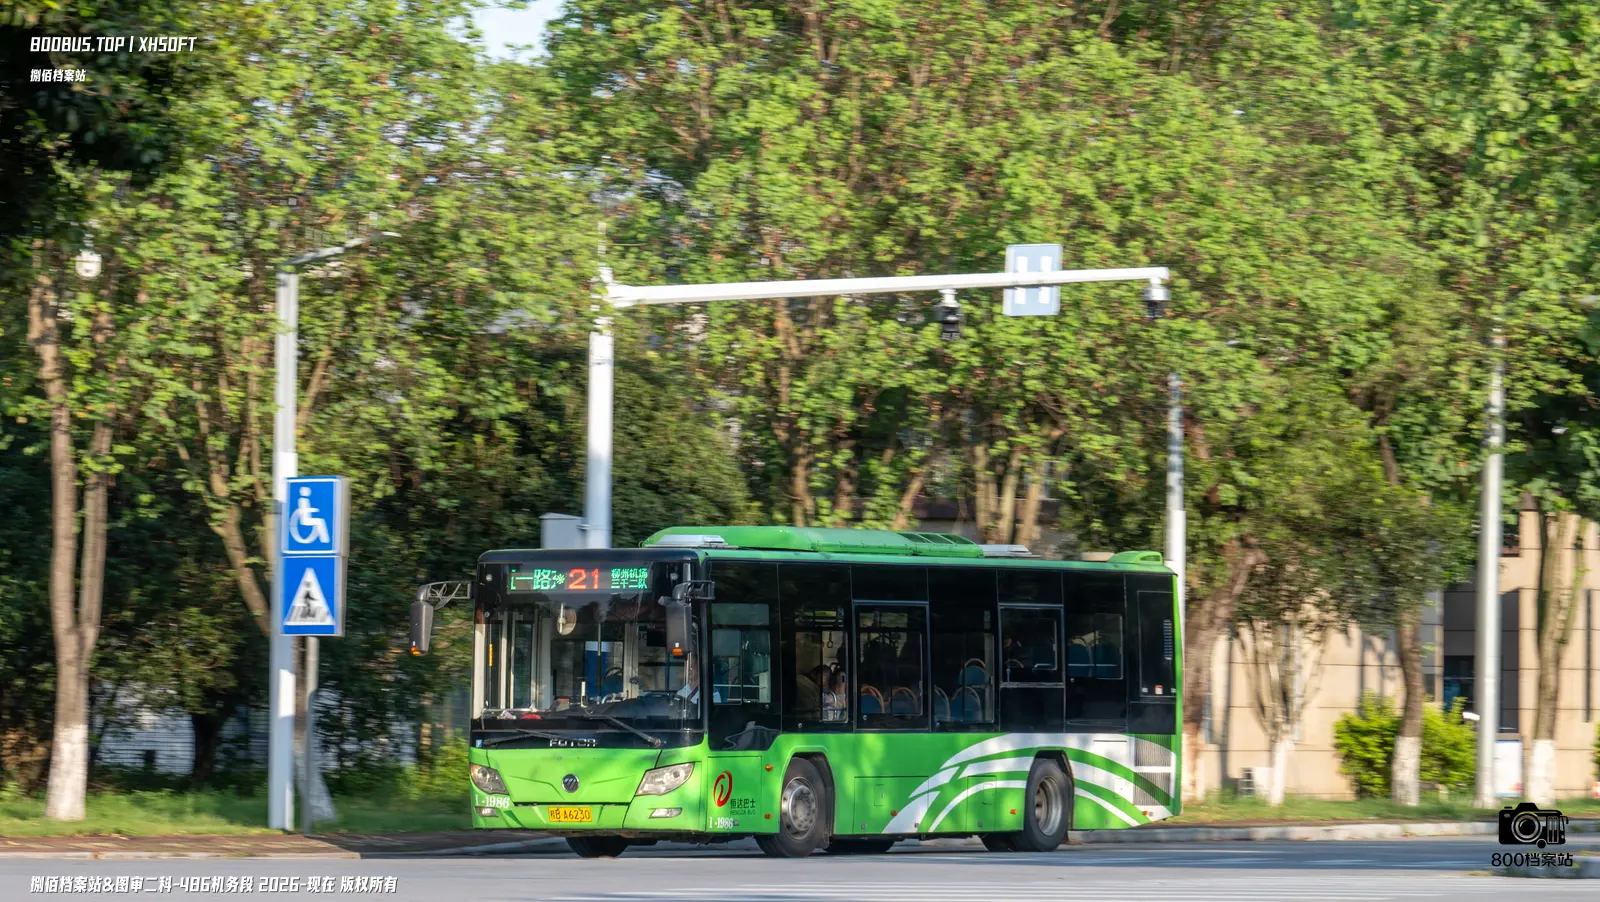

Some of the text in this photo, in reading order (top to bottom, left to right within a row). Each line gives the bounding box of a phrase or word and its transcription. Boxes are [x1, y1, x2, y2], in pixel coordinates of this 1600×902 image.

[568, 567, 600, 590] 21
[611, 568, 649, 579] 柳州机场
[730, 798, 757, 809] 恒达巴士
